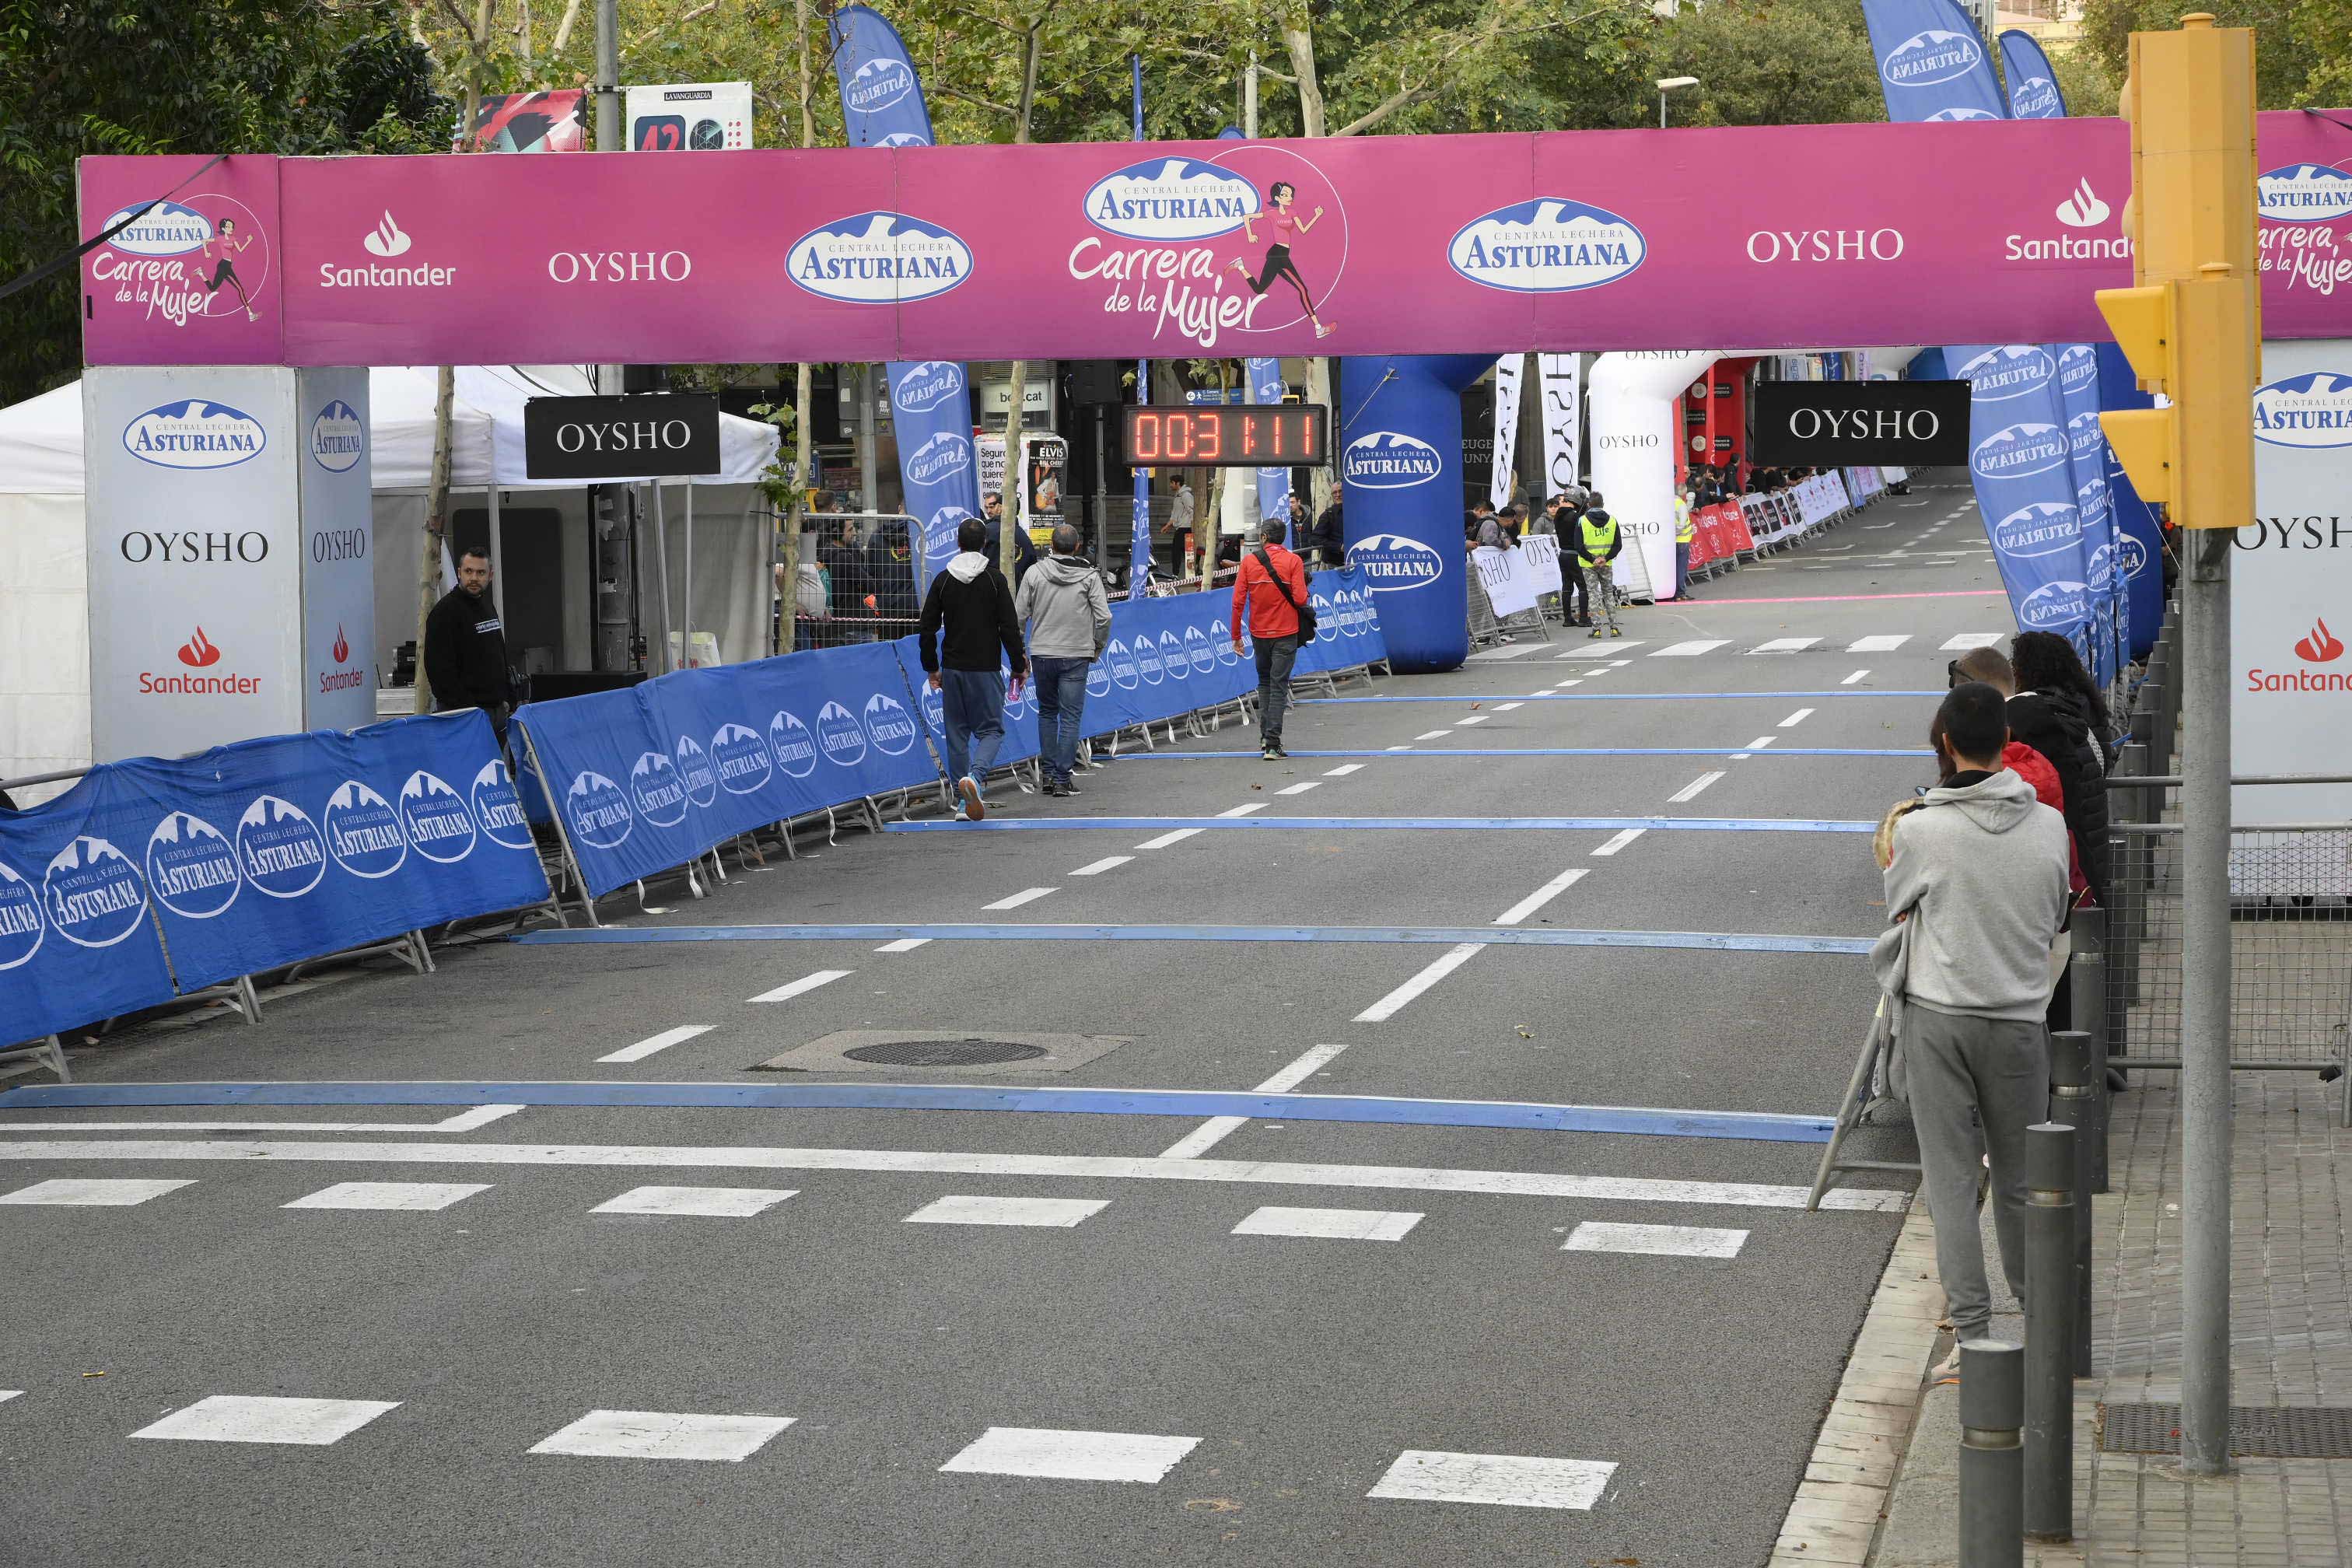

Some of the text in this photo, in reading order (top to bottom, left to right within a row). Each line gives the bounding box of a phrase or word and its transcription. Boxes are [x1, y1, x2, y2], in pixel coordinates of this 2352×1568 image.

[640, 124, 681, 151] 42
[1124, 186, 1180, 194] CENTRAL
[1097, 189, 1246, 220] ASTURIANA
[111, 220, 205, 241] ASTURIANA
[1494, 229, 1624, 240] CENTRAL LECHERA
[2258, 226, 2333, 249] arrera
[828, 243, 952, 253] CENTRAL LECHERA
[1069, 236, 1214, 280] Carrera
[1463, 234, 1631, 269] ASTURIANA
[1746, 229, 1904, 263] OYSHO
[2005, 234, 2134, 261] Santand
[93, 252, 184, 281] Carrera
[548, 250, 691, 283] OYSHO
[800, 247, 959, 280] ASTURIANA
[2277, 249, 2291, 271] la
[2287, 244, 2352, 296] Muje
[320, 261, 457, 288] Santander
[115, 281, 149, 302] de la
[145, 278, 219, 327] Mujer
[1104, 281, 1157, 312] de la
[1153, 275, 1269, 348] Mujer
[556, 420, 691, 453] OYSHO
[1137, 415, 1311, 457] 00:31:11
[1789, 408, 1939, 440] OYSHO
[135, 425, 256, 451] ASTURIANA
[315, 426, 360, 454] ASTURIANA
[1461, 439, 1493, 450] EUGE
[1600, 434, 1658, 450] OYSHO
[981, 460, 994, 470] que
[1039, 447, 1063, 457] ELVIS
[1346, 454, 1434, 476] ASTURIANA
[1461, 453, 1493, 464] UNY
[1594, 526, 1609, 537] Life
[1623, 523, 1660, 536] SHO
[2231, 516, 2352, 551] OYSH
[121, 531, 268, 562] OYSHO
[313, 528, 365, 562] OYSHO
[1525, 537, 1552, 566] OYS
[1349, 557, 1435, 576] ATURIANA
[138, 672, 261, 694] Santander
[320, 667, 363, 693] Santander
[339, 814, 367, 826] CENTRAL
[412, 799, 460, 814] CENTRAL LECHERA
[479, 796, 523, 830] ASTUR
[253, 825, 310, 844] CENTRAL LECHERA
[332, 821, 403, 857] ASTURIANA
[406, 808, 472, 844] ASTURIANA
[164, 842, 225, 862] CENTRAL LECHERA
[244, 838, 323, 877] ASTURIANA
[156, 856, 237, 897] ASTURIANA
[0, 886, 26, 899] ECHERA
